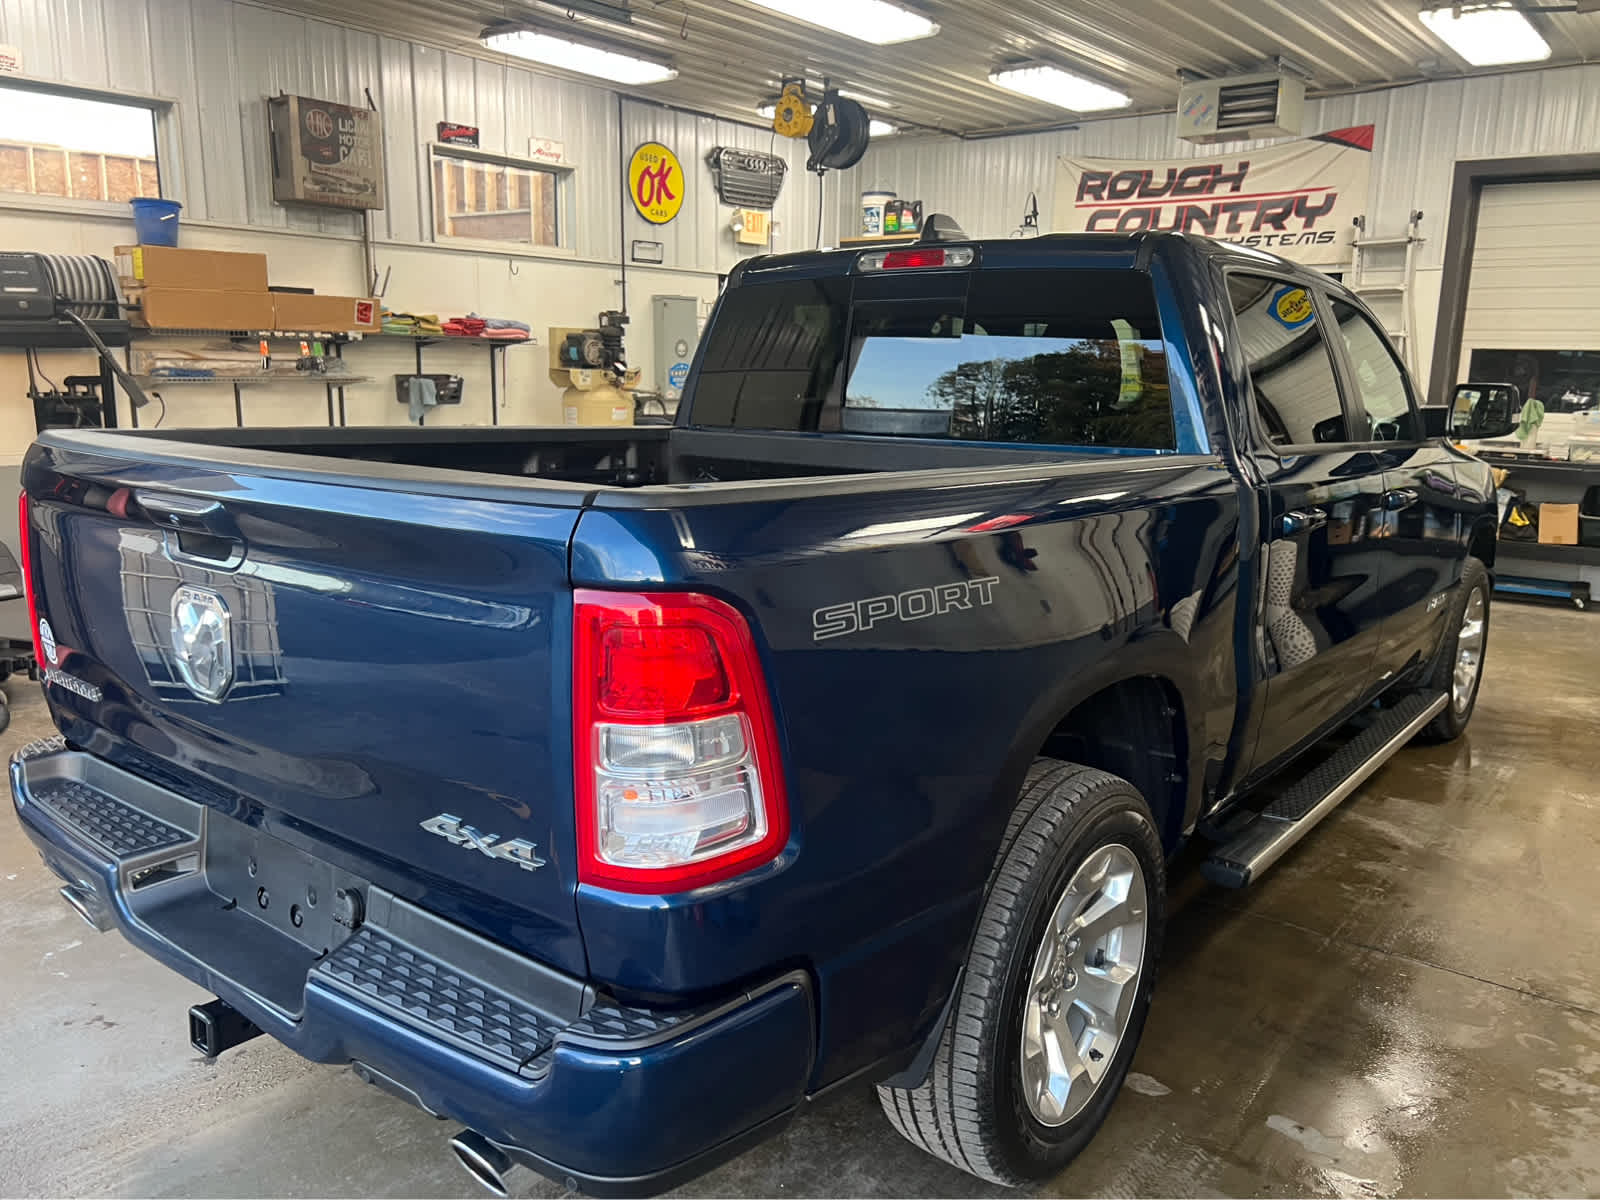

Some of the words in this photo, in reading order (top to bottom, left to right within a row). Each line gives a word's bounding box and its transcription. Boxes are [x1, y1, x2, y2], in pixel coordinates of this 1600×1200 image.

[640, 151, 658, 163] USED
[637, 157, 676, 208] OK
[1076, 161, 1250, 202] ROUGH
[650, 208, 668, 217] CARS
[745, 212, 764, 233] EXIT
[1085, 193, 1338, 235] COUNTRY
[812, 576, 1000, 641] SPORT
